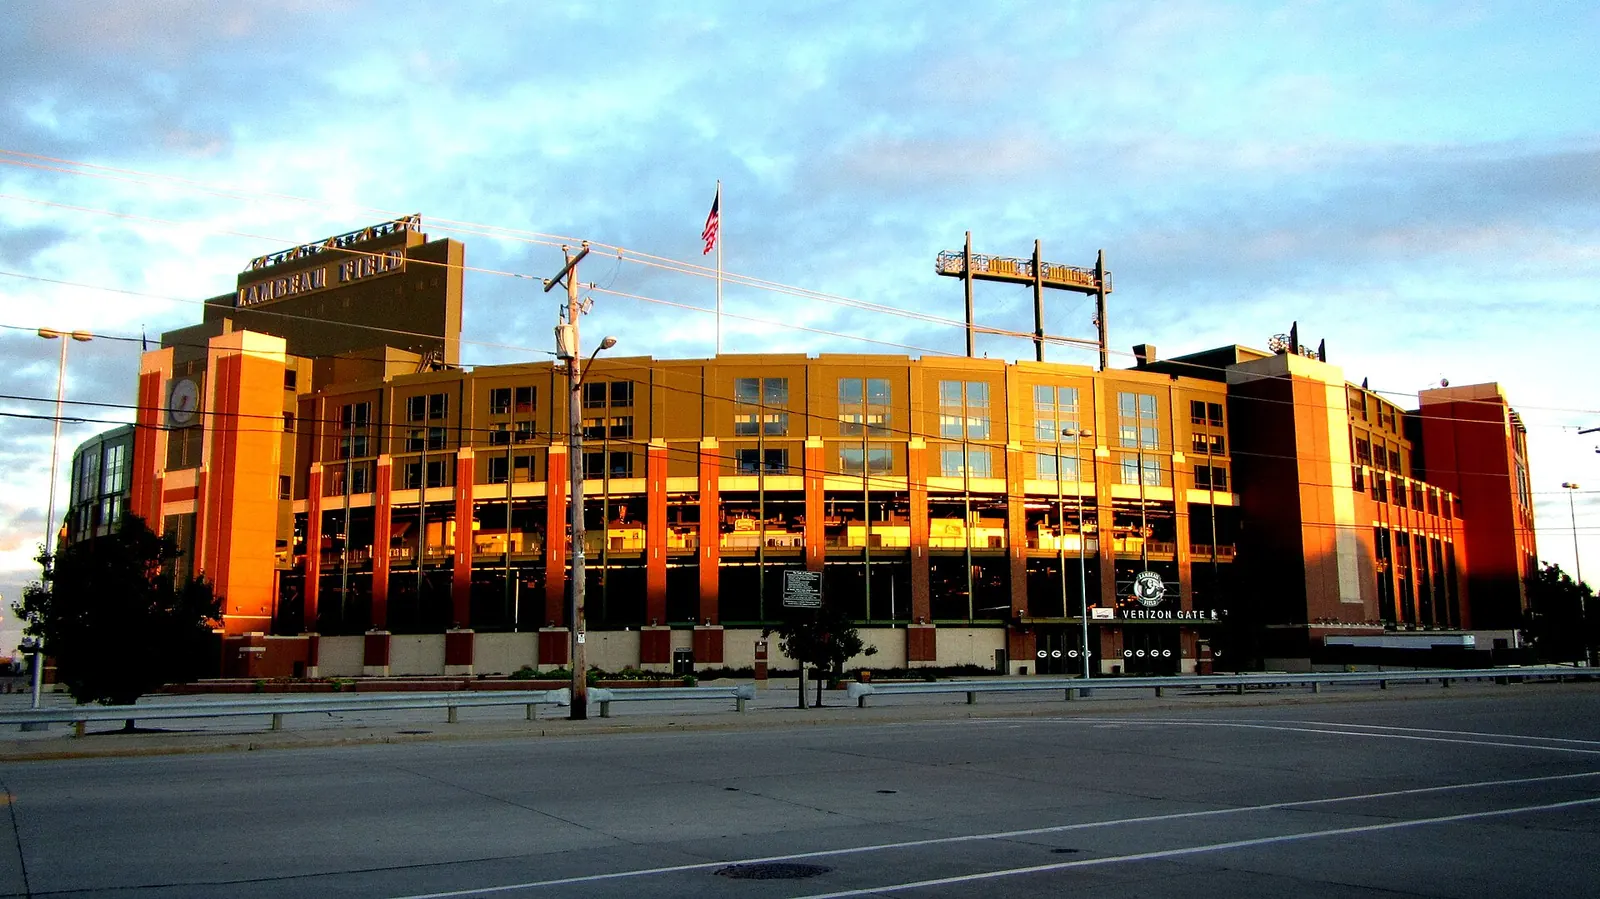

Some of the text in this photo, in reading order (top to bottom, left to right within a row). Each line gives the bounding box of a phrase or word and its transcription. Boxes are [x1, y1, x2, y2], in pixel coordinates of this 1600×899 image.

[236, 249, 403, 307] LAMBEAU FIELD
[1123, 609, 1172, 619] VERIZON
[1177, 609, 1205, 619] GATE
